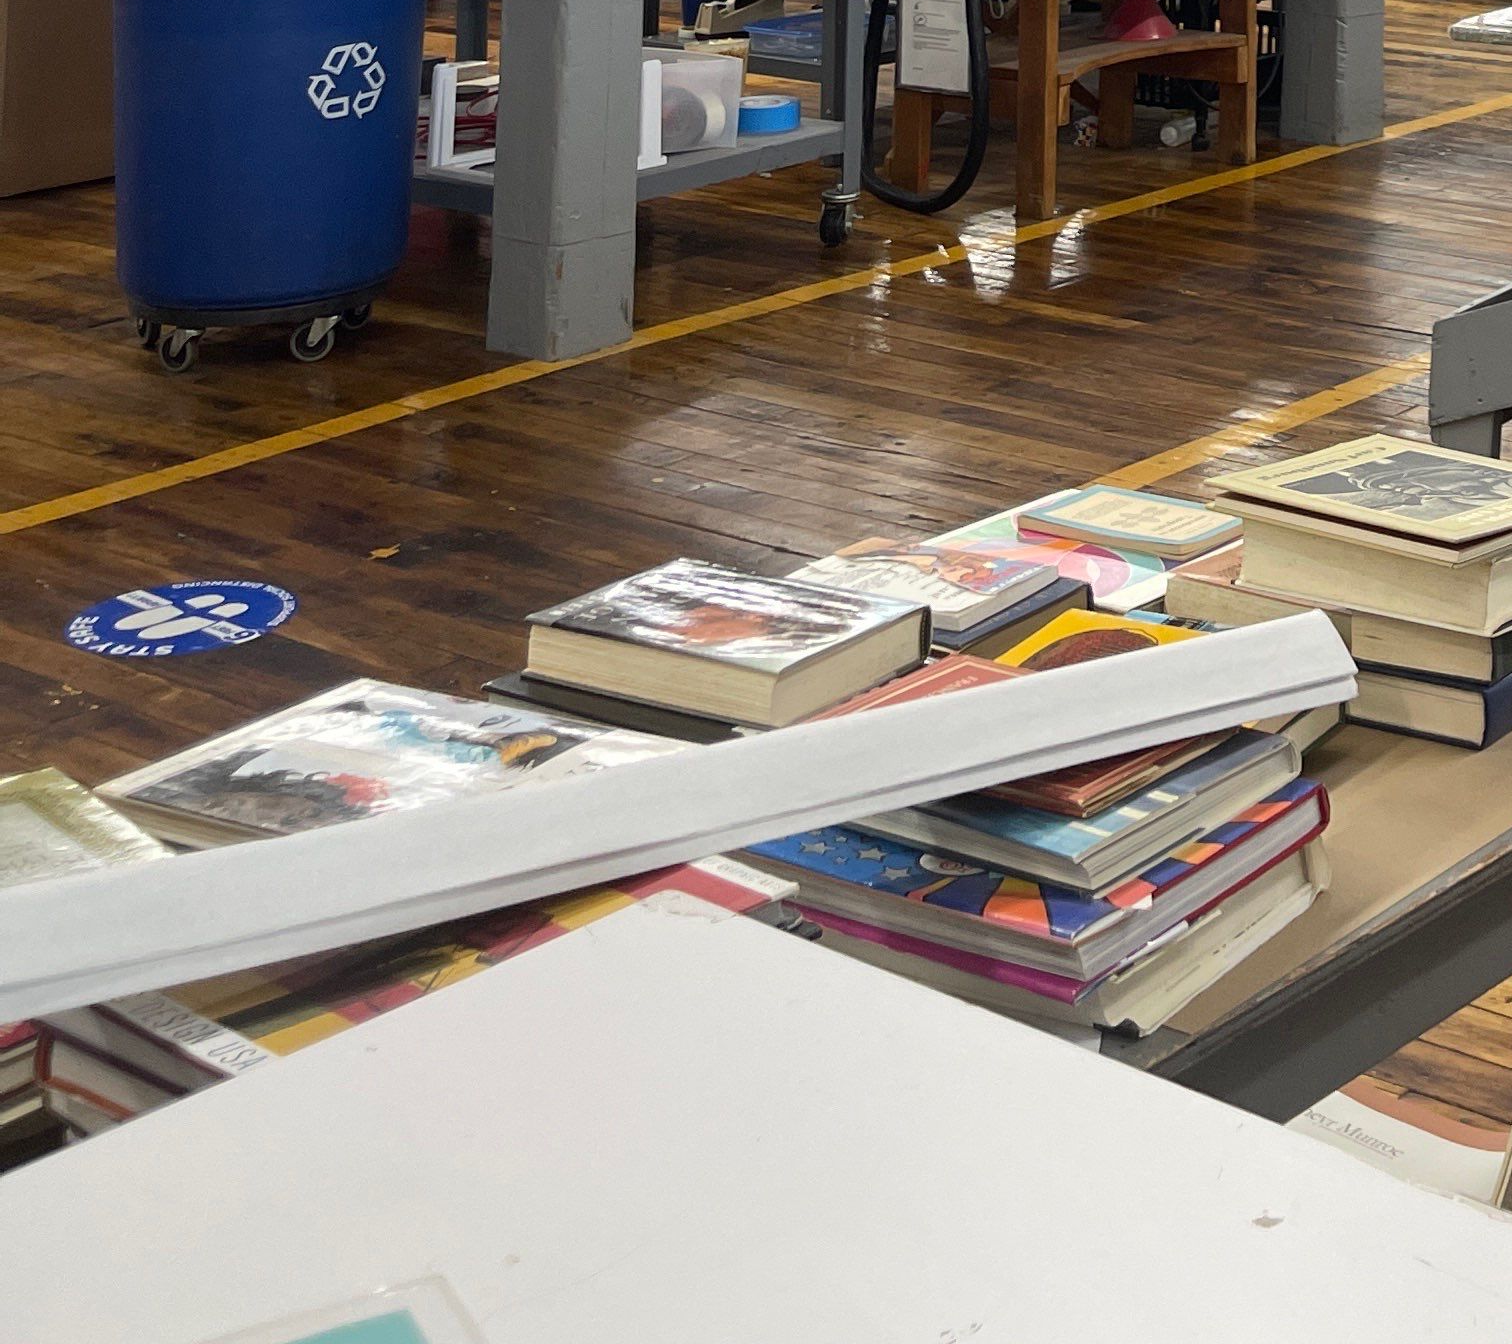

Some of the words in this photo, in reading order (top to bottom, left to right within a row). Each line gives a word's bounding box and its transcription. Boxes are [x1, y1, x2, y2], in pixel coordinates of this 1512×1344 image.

[68, 615, 100, 645] SAFE
[88, 641, 175, 656] STAY
[130, 999, 226, 1045] DESIGN
[207, 1040, 269, 1071] USA
